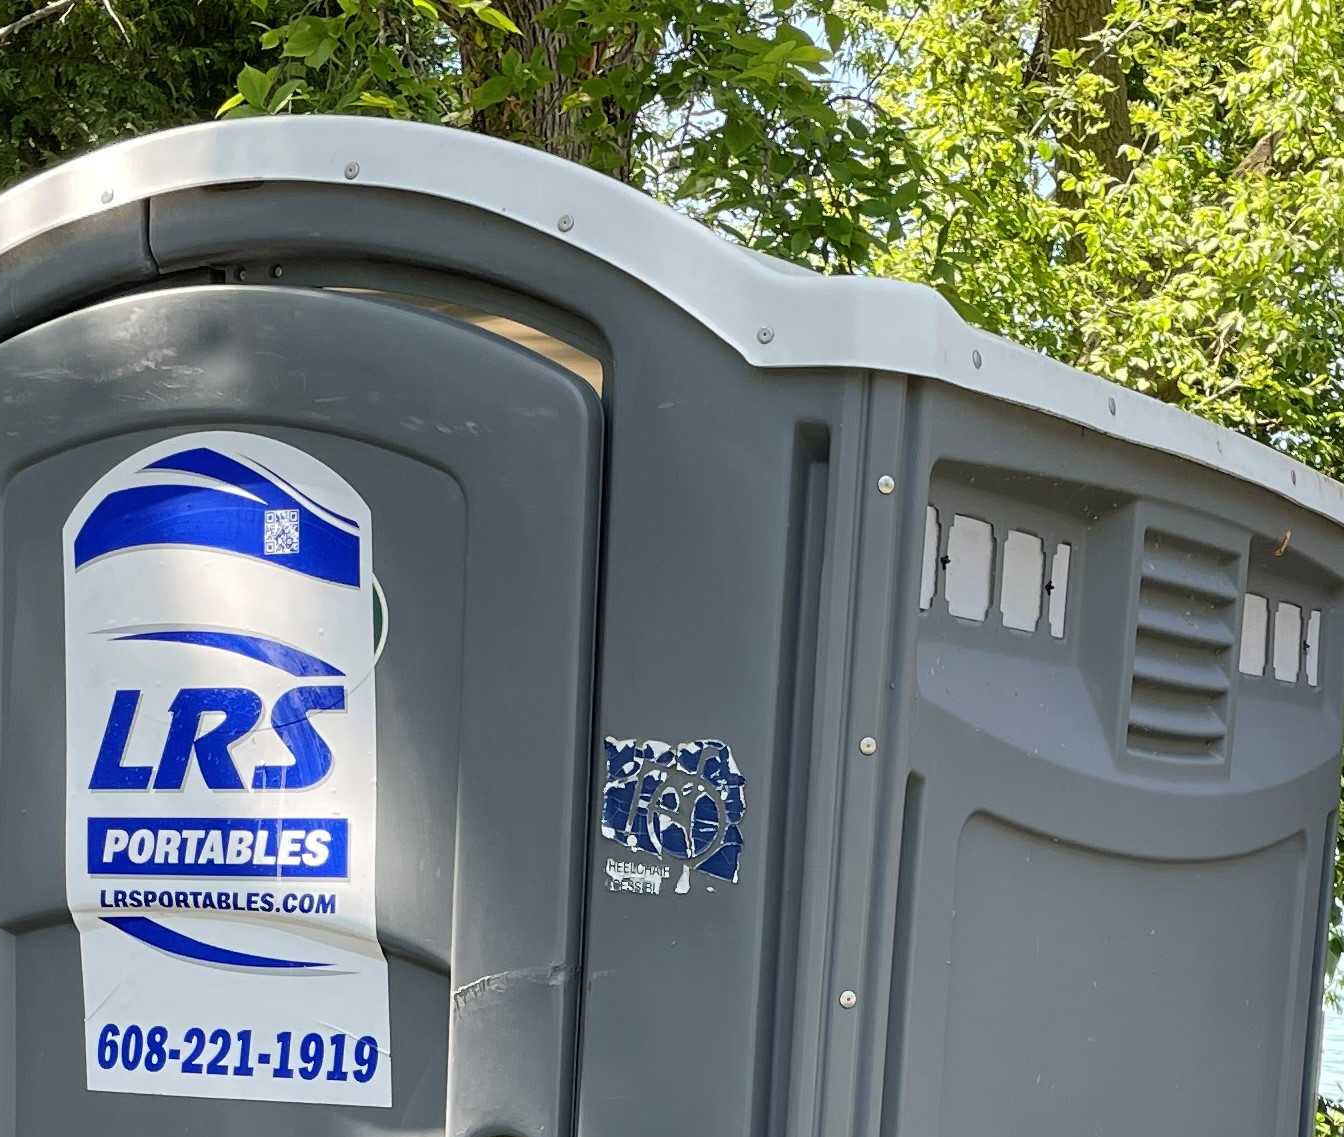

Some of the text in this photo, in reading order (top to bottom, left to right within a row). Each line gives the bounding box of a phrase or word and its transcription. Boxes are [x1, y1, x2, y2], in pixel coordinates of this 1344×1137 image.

[88, 685, 347, 791] LRS
[102, 829, 332, 867] PORTABLES
[99, 890, 337, 914] LRSPORTABLES.COM
[97, 1023, 379, 1084] 608-221-1919
